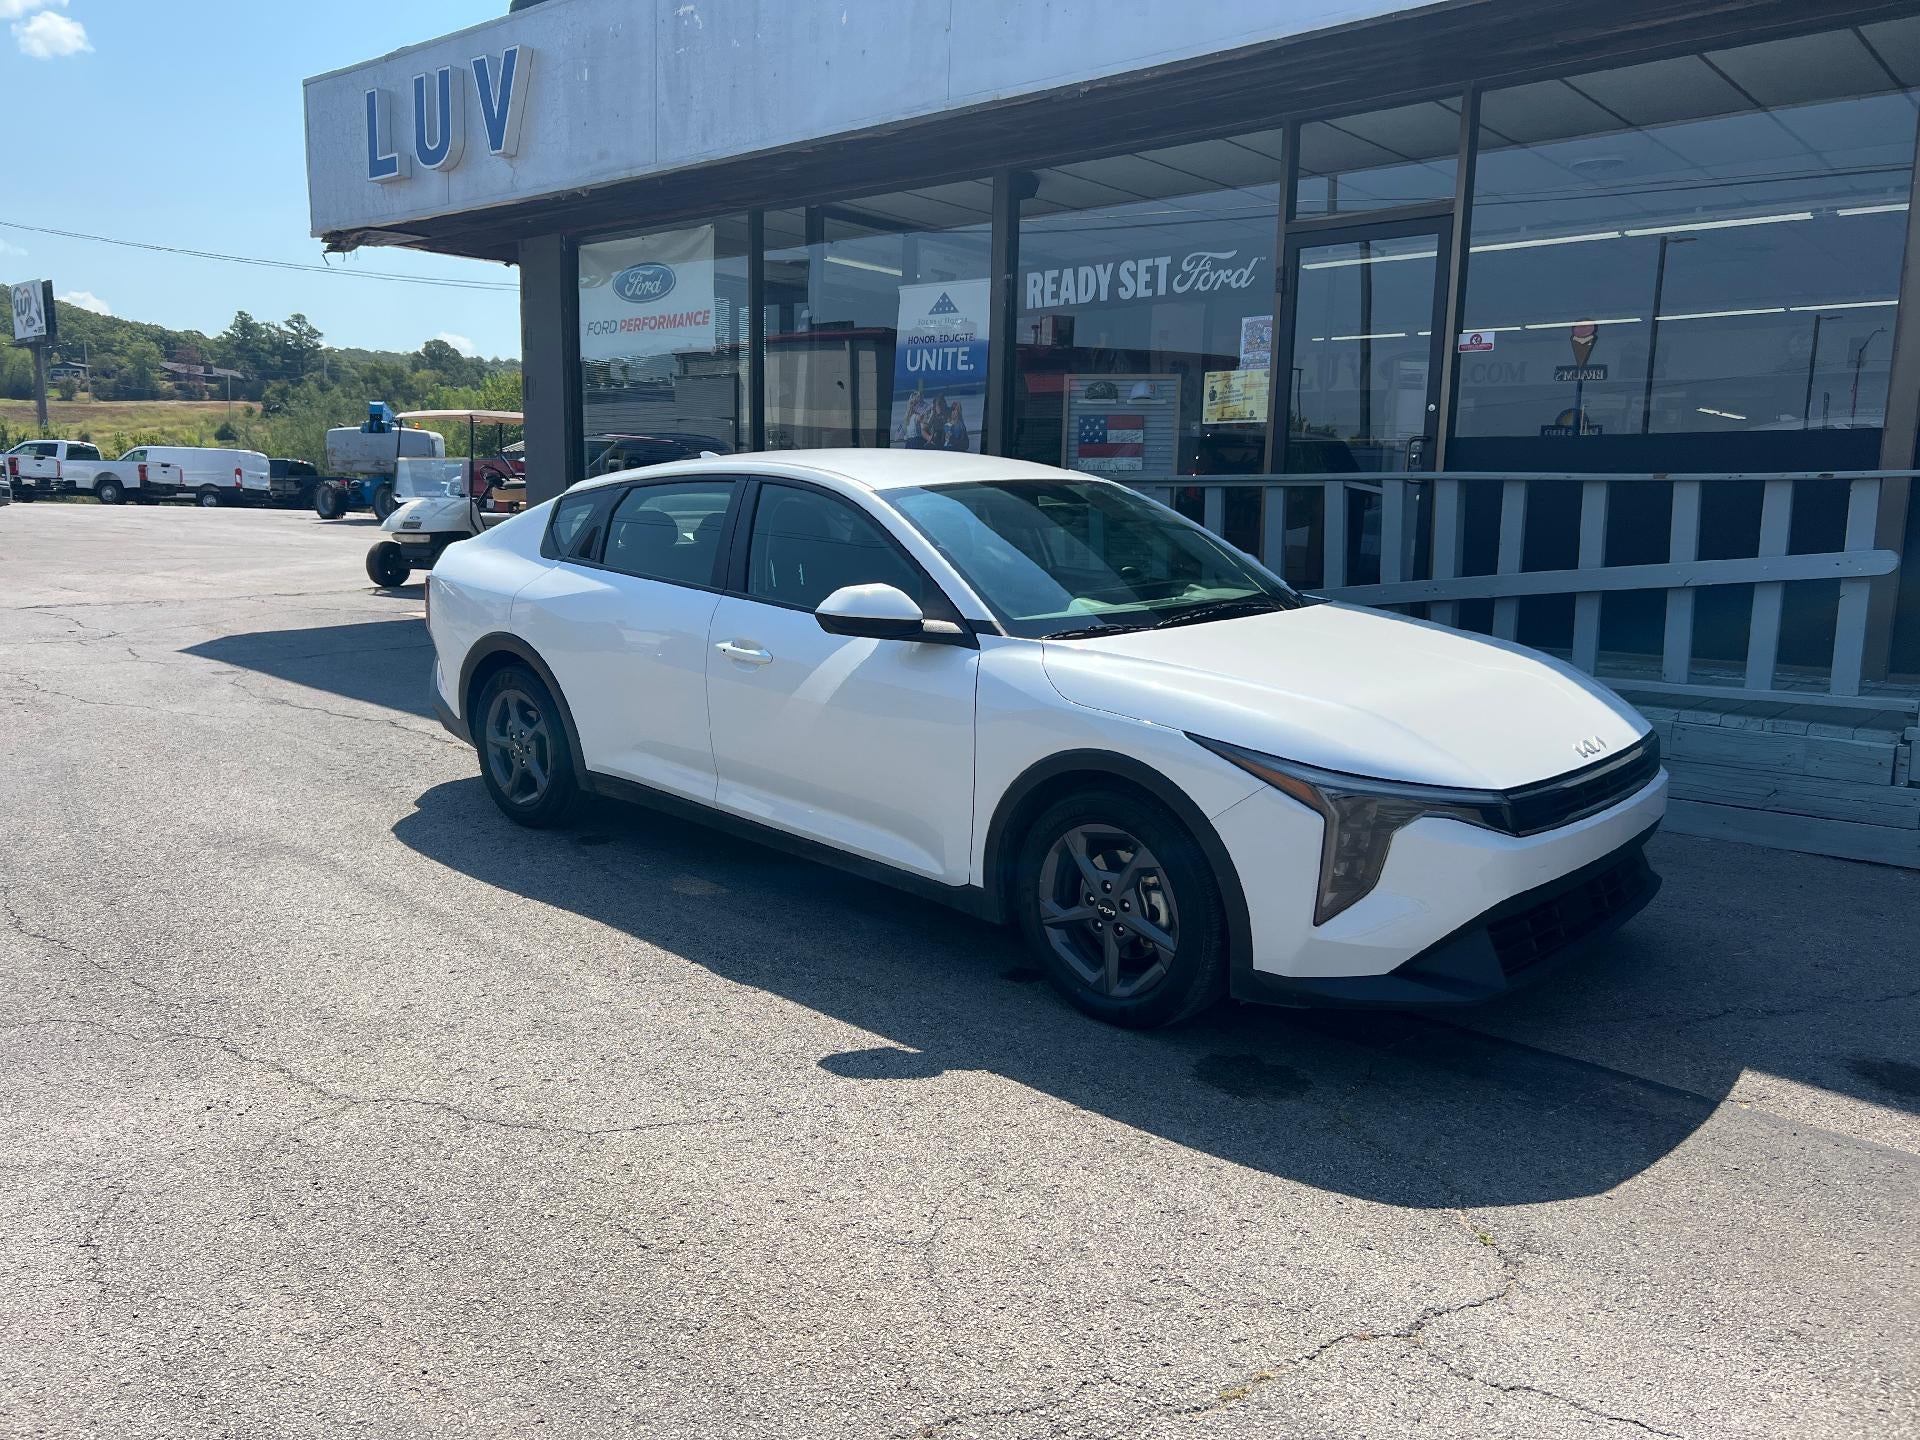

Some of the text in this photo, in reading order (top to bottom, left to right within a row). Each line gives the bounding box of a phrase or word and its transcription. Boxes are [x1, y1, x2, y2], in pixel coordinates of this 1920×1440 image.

[365, 45, 527, 183] LUV
[624, 270, 663, 297] Ford
[1026, 263, 1114, 310] READY
[1118, 256, 1172, 300] SET
[1172, 249, 1259, 294] Ford
[16, 295, 32, 318] LUV
[587, 309, 711, 337] FORD PERFORMANCE
[907, 335, 938, 345] HONOR.
[906, 346, 974, 372] UNITE.
